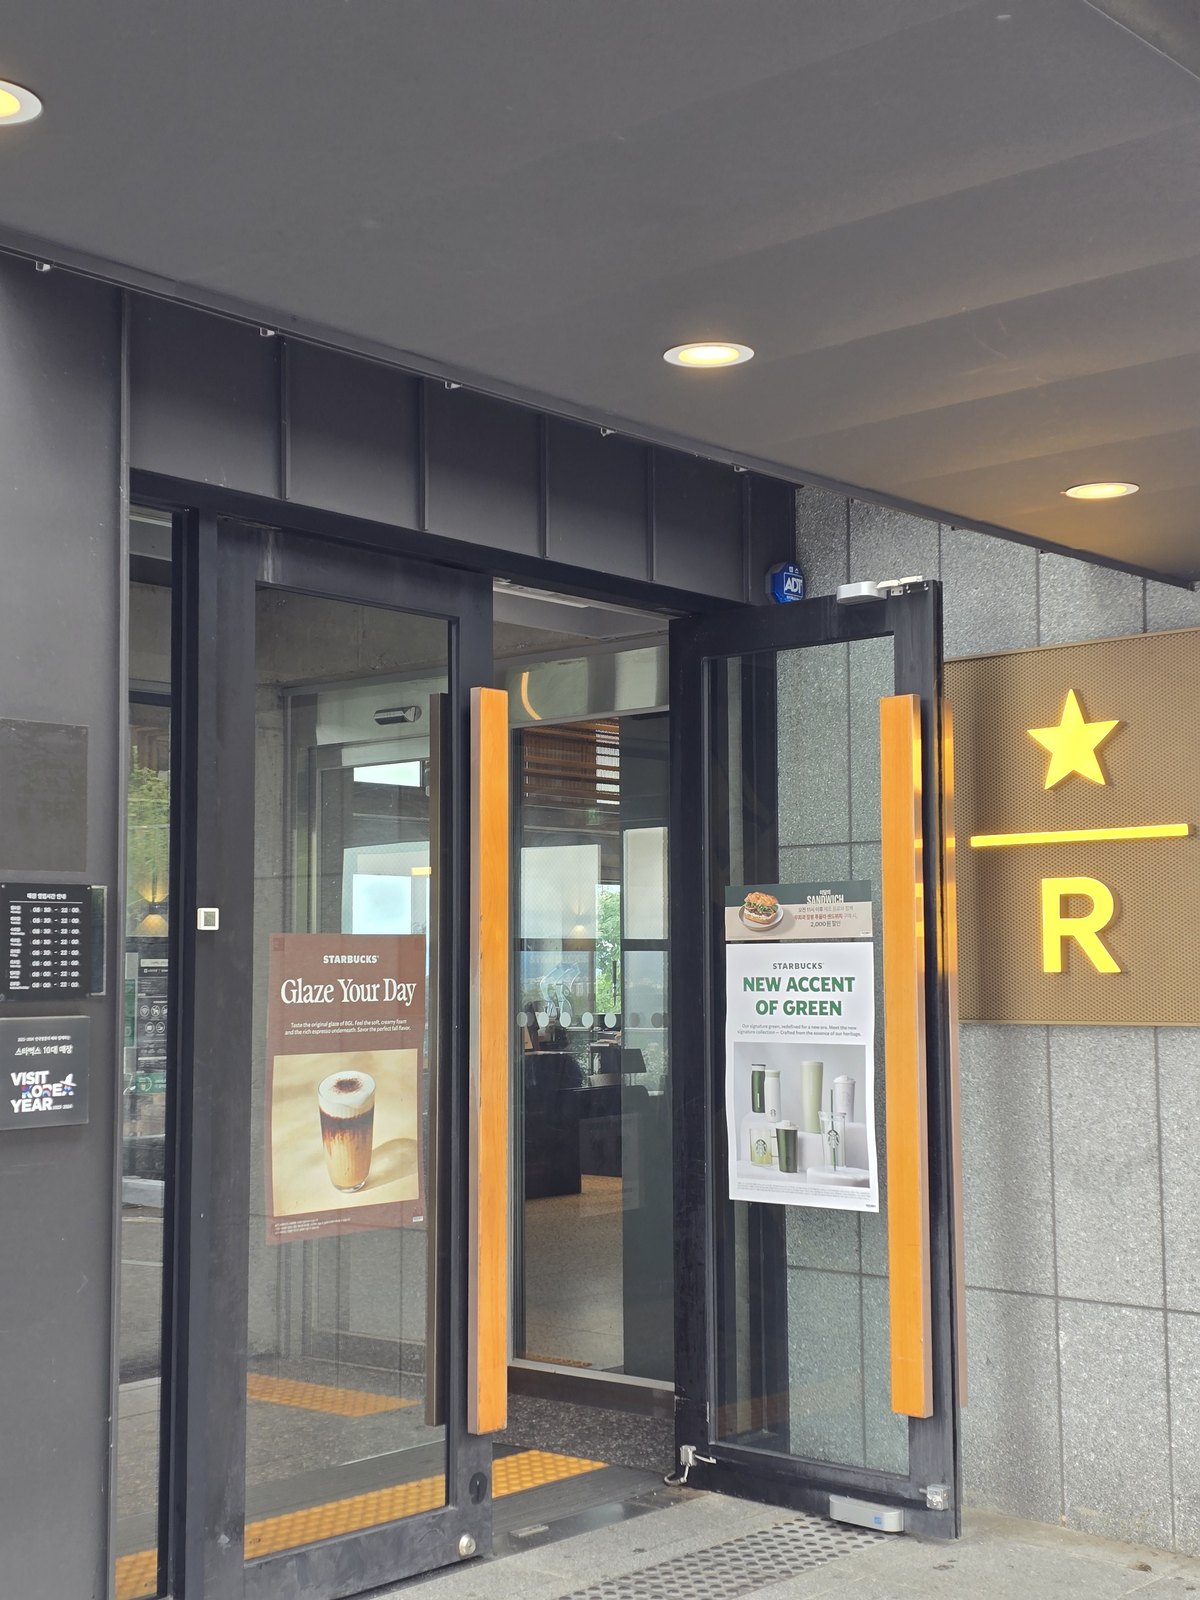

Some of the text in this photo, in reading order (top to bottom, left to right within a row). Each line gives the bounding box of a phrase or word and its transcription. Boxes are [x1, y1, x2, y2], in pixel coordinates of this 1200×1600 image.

[785, 577, 802, 594] ADT
[806, 894, 844, 905] SANDWICH
[1041, 876, 1121, 973] R
[323, 955, 378, 964] STARBUCKS
[772, 962, 823, 970] STARBUCKS
[281, 978, 416, 1007] Glaze Your Day
[743, 976, 856, 993] NEW ACCENT
[755, 999, 842, 1016] OF GREEN
[311, 1021, 328, 1029] original
[15, 1046, 41, 1056] 스타벅스
[10, 1070, 50, 1086] VISIT
[20, 1081, 75, 1098] KOREA
[10, 1097, 53, 1113] YEAR
